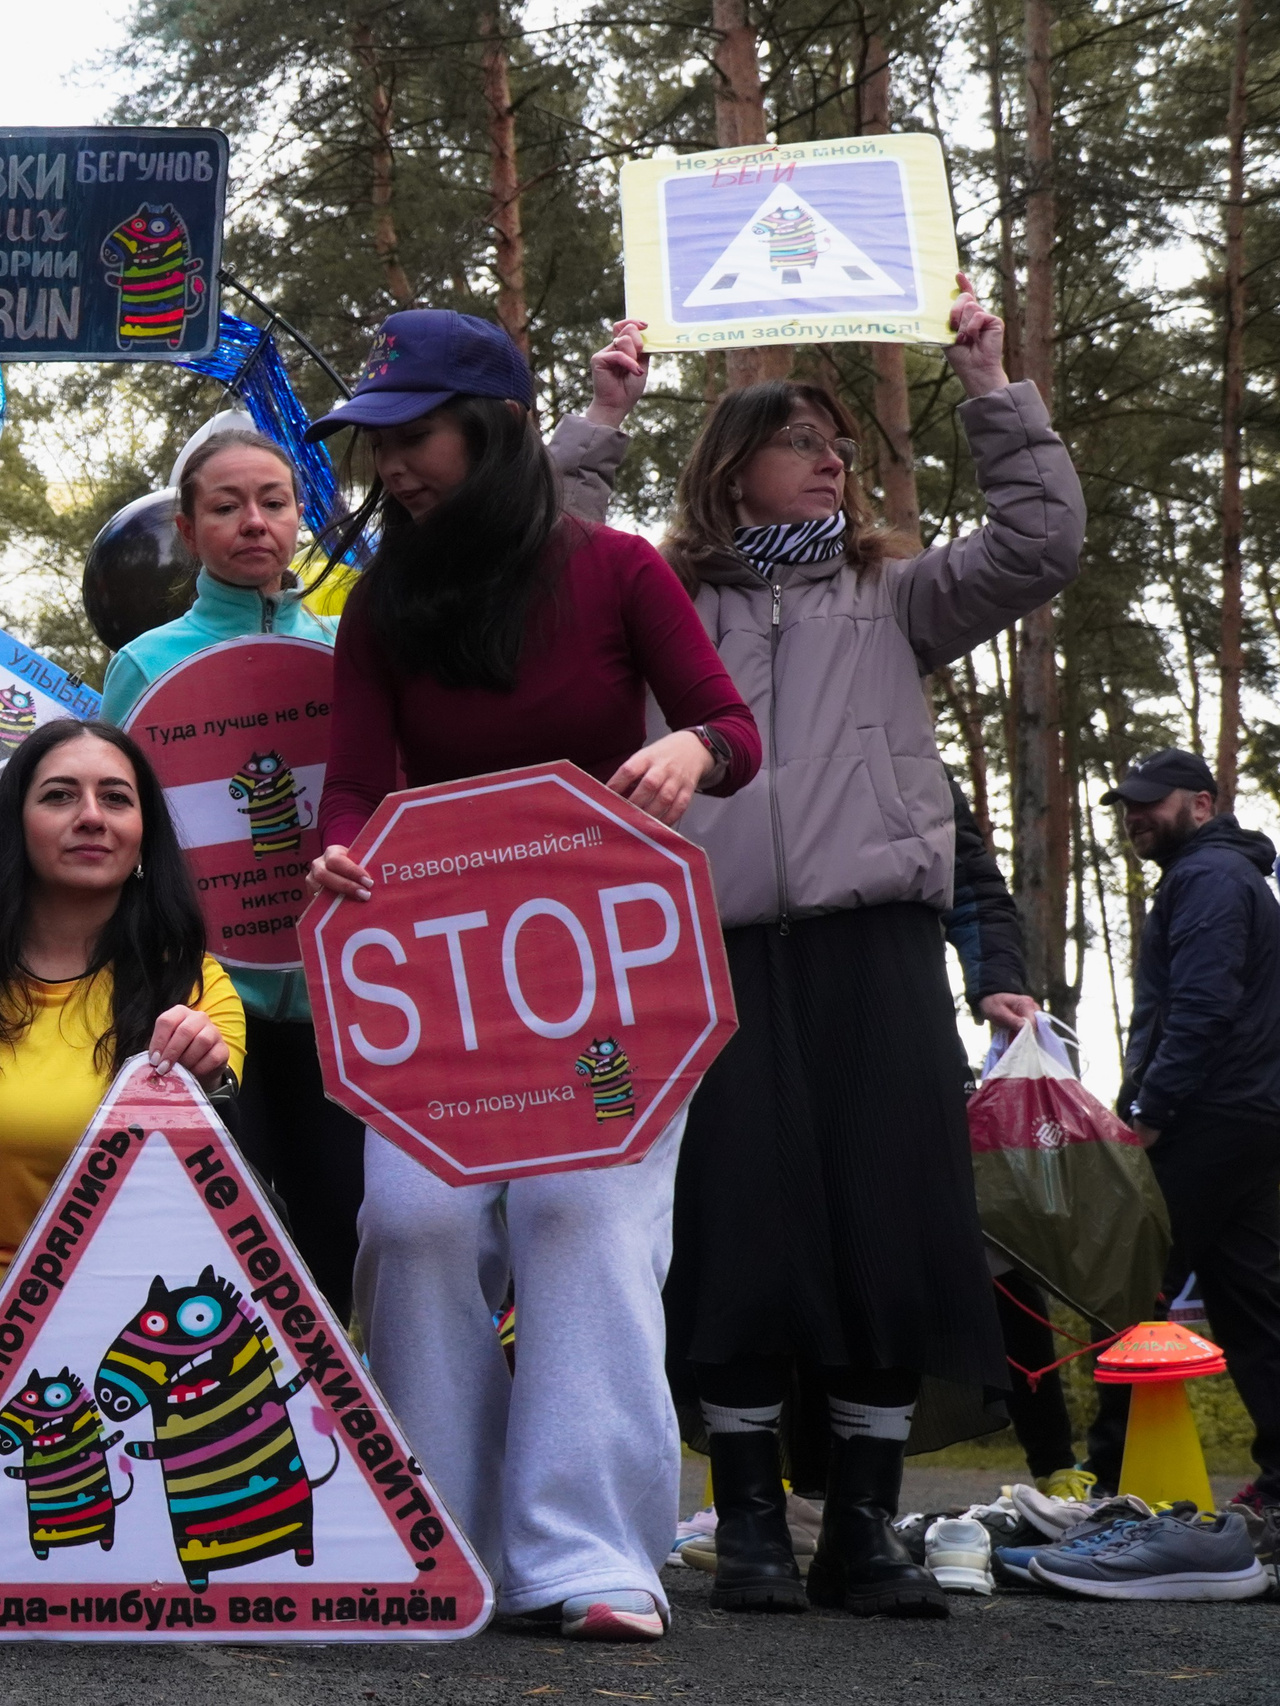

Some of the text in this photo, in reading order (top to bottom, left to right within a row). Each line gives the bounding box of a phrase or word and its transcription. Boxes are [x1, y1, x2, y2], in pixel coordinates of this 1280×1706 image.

[76, 149, 213, 184] БЕГУНОВ
[676, 140, 885, 171] Не ходи за мной,
[711, 161, 797, 188] БЕГИ
[676, 321, 921, 344] я сам заблудился!
[145, 701, 332, 746] Туда лучше не бе
[381, 825, 603, 884] Разворачивайся!!!
[197, 861, 310, 891] оттуда пок
[241, 889, 303, 909] никто
[222, 915, 298, 939] возвра
[340, 881, 681, 1066] STOP
[428, 1085, 576, 1121] Это ловушка
[185, 1145, 444, 1571] не переживайте,
[229, 1596, 297, 1624] вас
[312, 1588, 457, 1626] найдём
